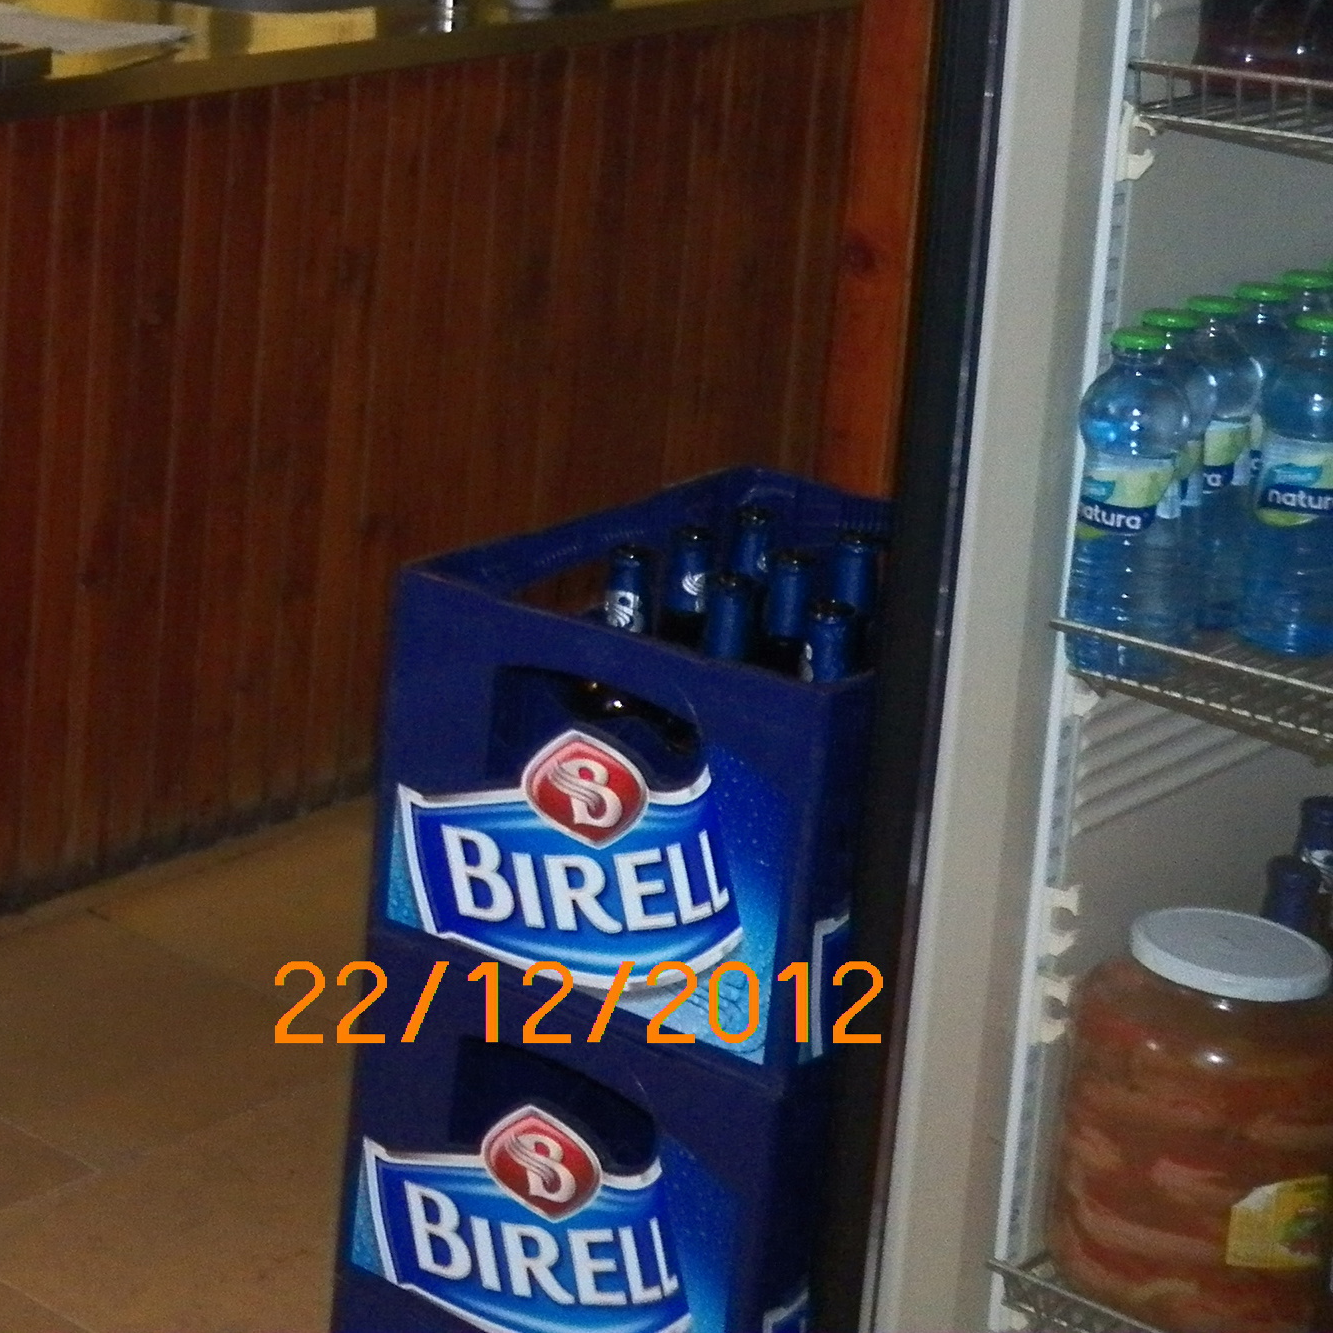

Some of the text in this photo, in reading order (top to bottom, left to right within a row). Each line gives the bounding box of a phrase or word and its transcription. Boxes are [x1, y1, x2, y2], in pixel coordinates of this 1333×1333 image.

[1078, 502, 1142, 530] atura
[1268, 489, 1333, 511] natur
[441, 824, 730, 935] BIRELL
[404, 1180, 679, 1306] BIRELL
